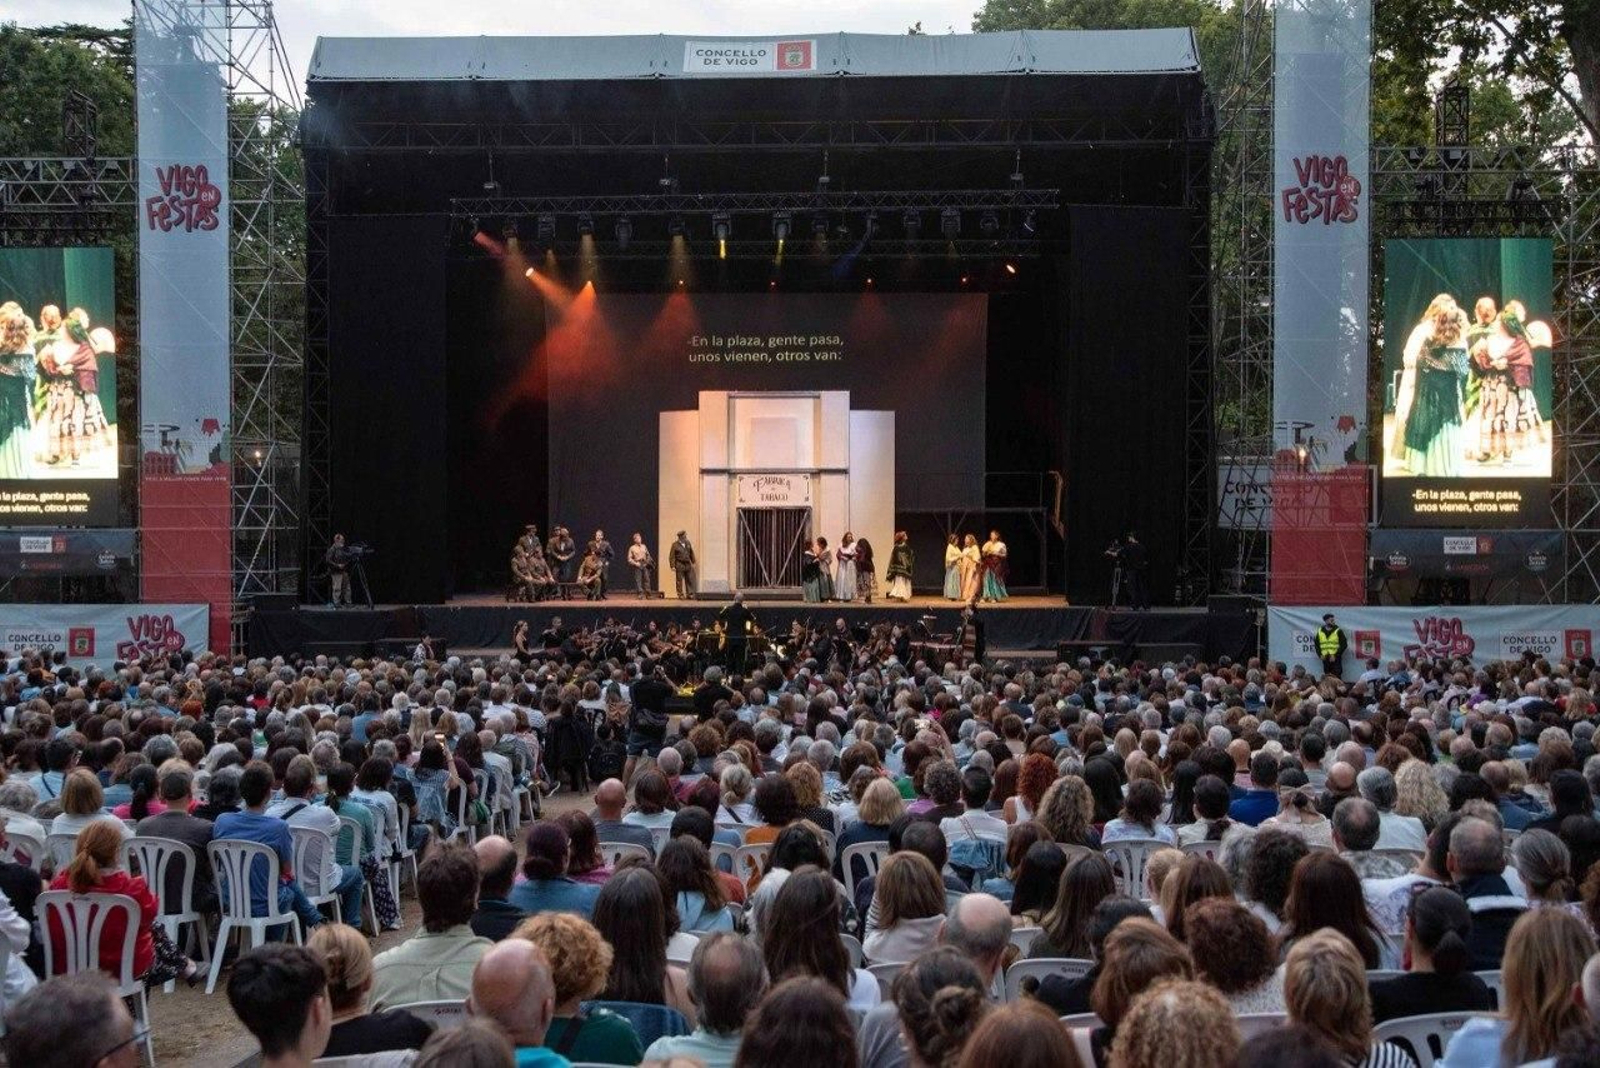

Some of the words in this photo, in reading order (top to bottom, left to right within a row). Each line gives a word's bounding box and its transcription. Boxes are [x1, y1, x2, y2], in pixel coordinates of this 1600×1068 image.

[695, 49, 767, 57] CONCELLO
[703, 58, 721, 66] DE
[725, 58, 758, 66] VIGO
[1292, 155, 1348, 189] VIGO
[156, 164, 208, 197] VIGO
[712, 335, 723, 347] la
[727, 335, 765, 348] plaza,
[768, 336, 806, 348] gente
[810, 335, 844, 347] pasa,
[689, 352, 721, 362] unos
[724, 351, 772, 363] vienen,
[776, 350, 811, 361] otros
[814, 351, 842, 361] van:
[127, 614, 174, 641] VIGO
[1412, 616, 1462, 644] VIGO
[8, 633, 62, 643] CONCELLO
[1503, 635, 1557, 645] CONCELLO
[1509, 645, 1522, 654] DE
